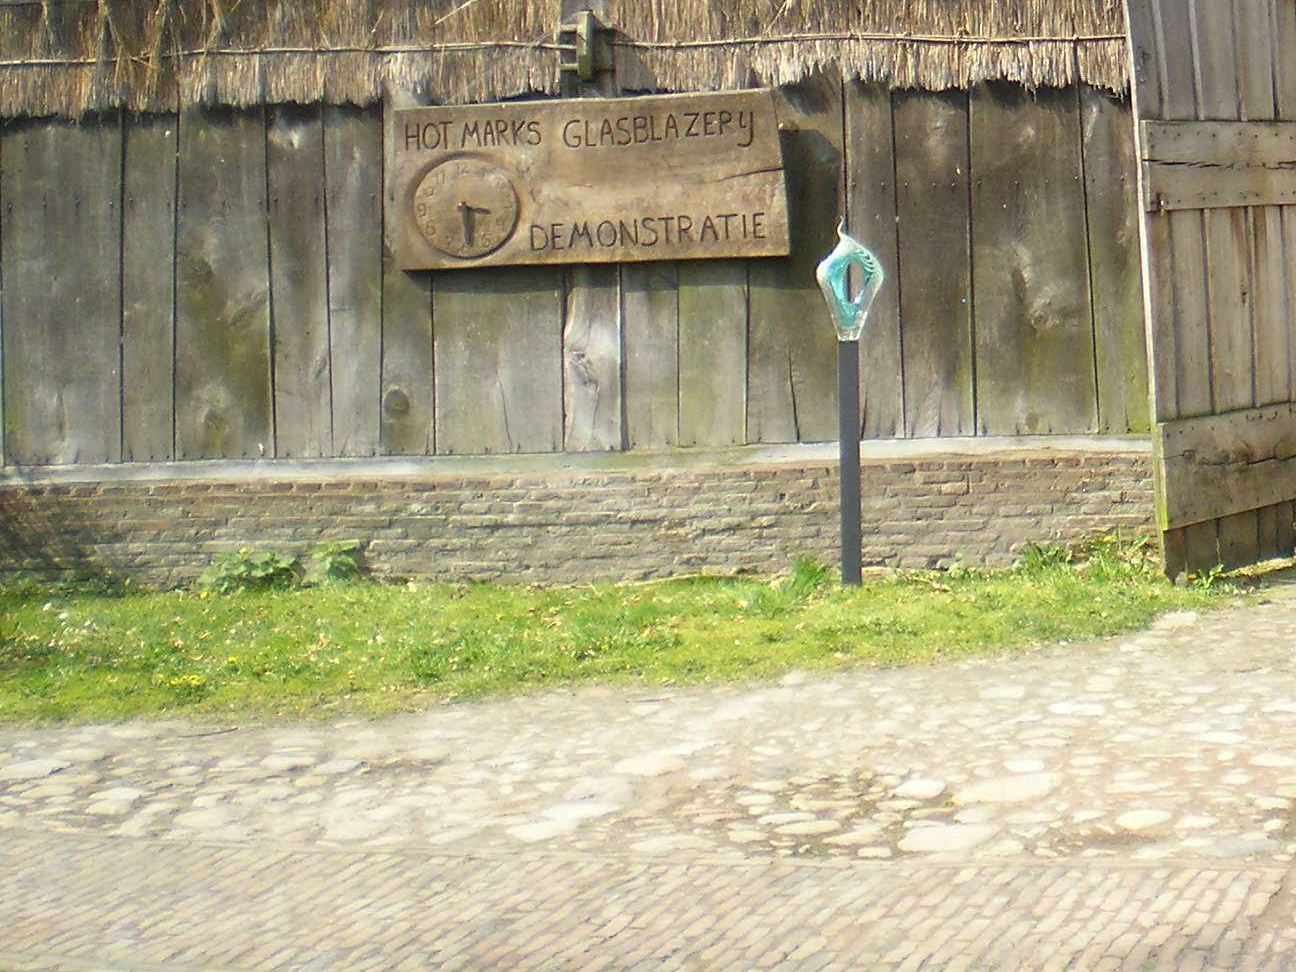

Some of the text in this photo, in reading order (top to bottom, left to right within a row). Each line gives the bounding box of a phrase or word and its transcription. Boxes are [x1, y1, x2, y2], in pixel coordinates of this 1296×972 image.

[404, 121, 453, 151] HOT
[460, 119, 543, 149] MARKS
[529, 212, 766, 252] DEMONSTRATIE
